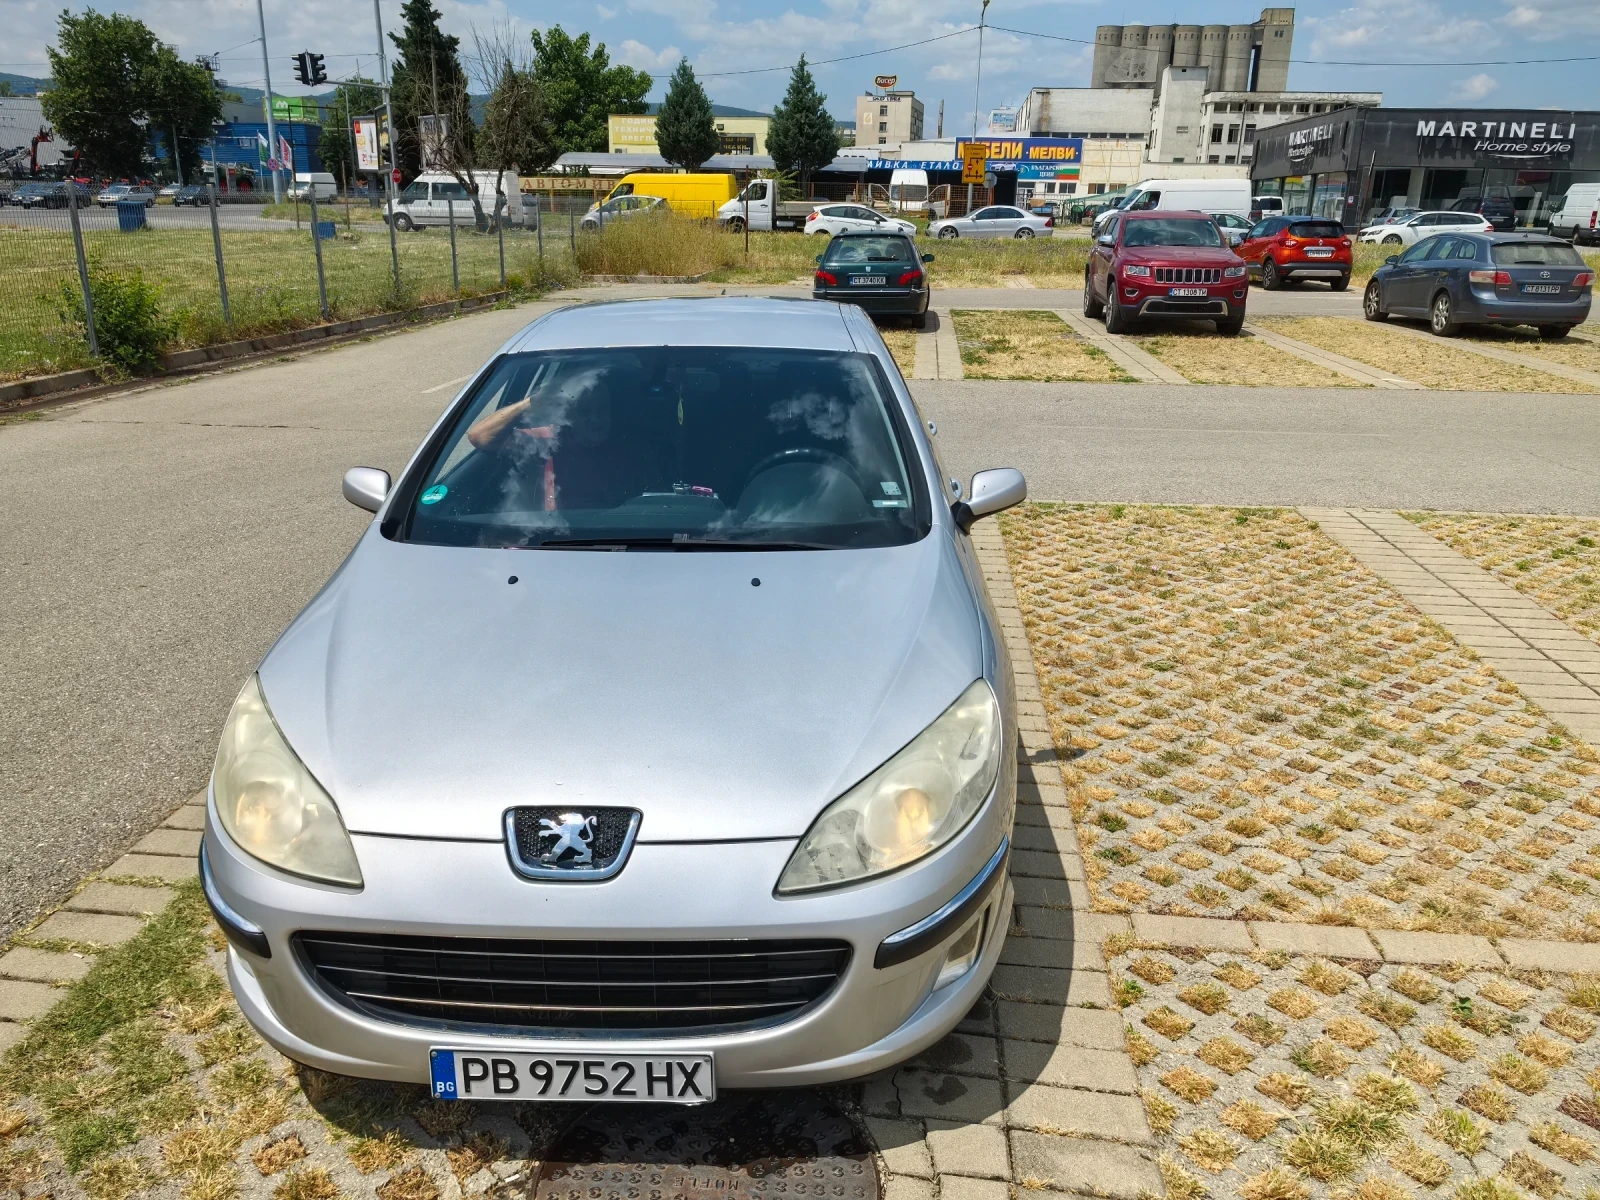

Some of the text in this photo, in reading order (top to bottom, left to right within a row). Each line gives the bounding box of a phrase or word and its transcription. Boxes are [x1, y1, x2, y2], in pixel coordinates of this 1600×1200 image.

[1288, 123, 1334, 146] MARTINELI
[1416, 120, 1576, 139] MARTINELI
[1474, 140, 1571, 154] Home style
[921, 161, 963, 170] ЕТАЛО
[529, 1060, 637, 1096] 9752
[436, 1080, 455, 1093] BG
